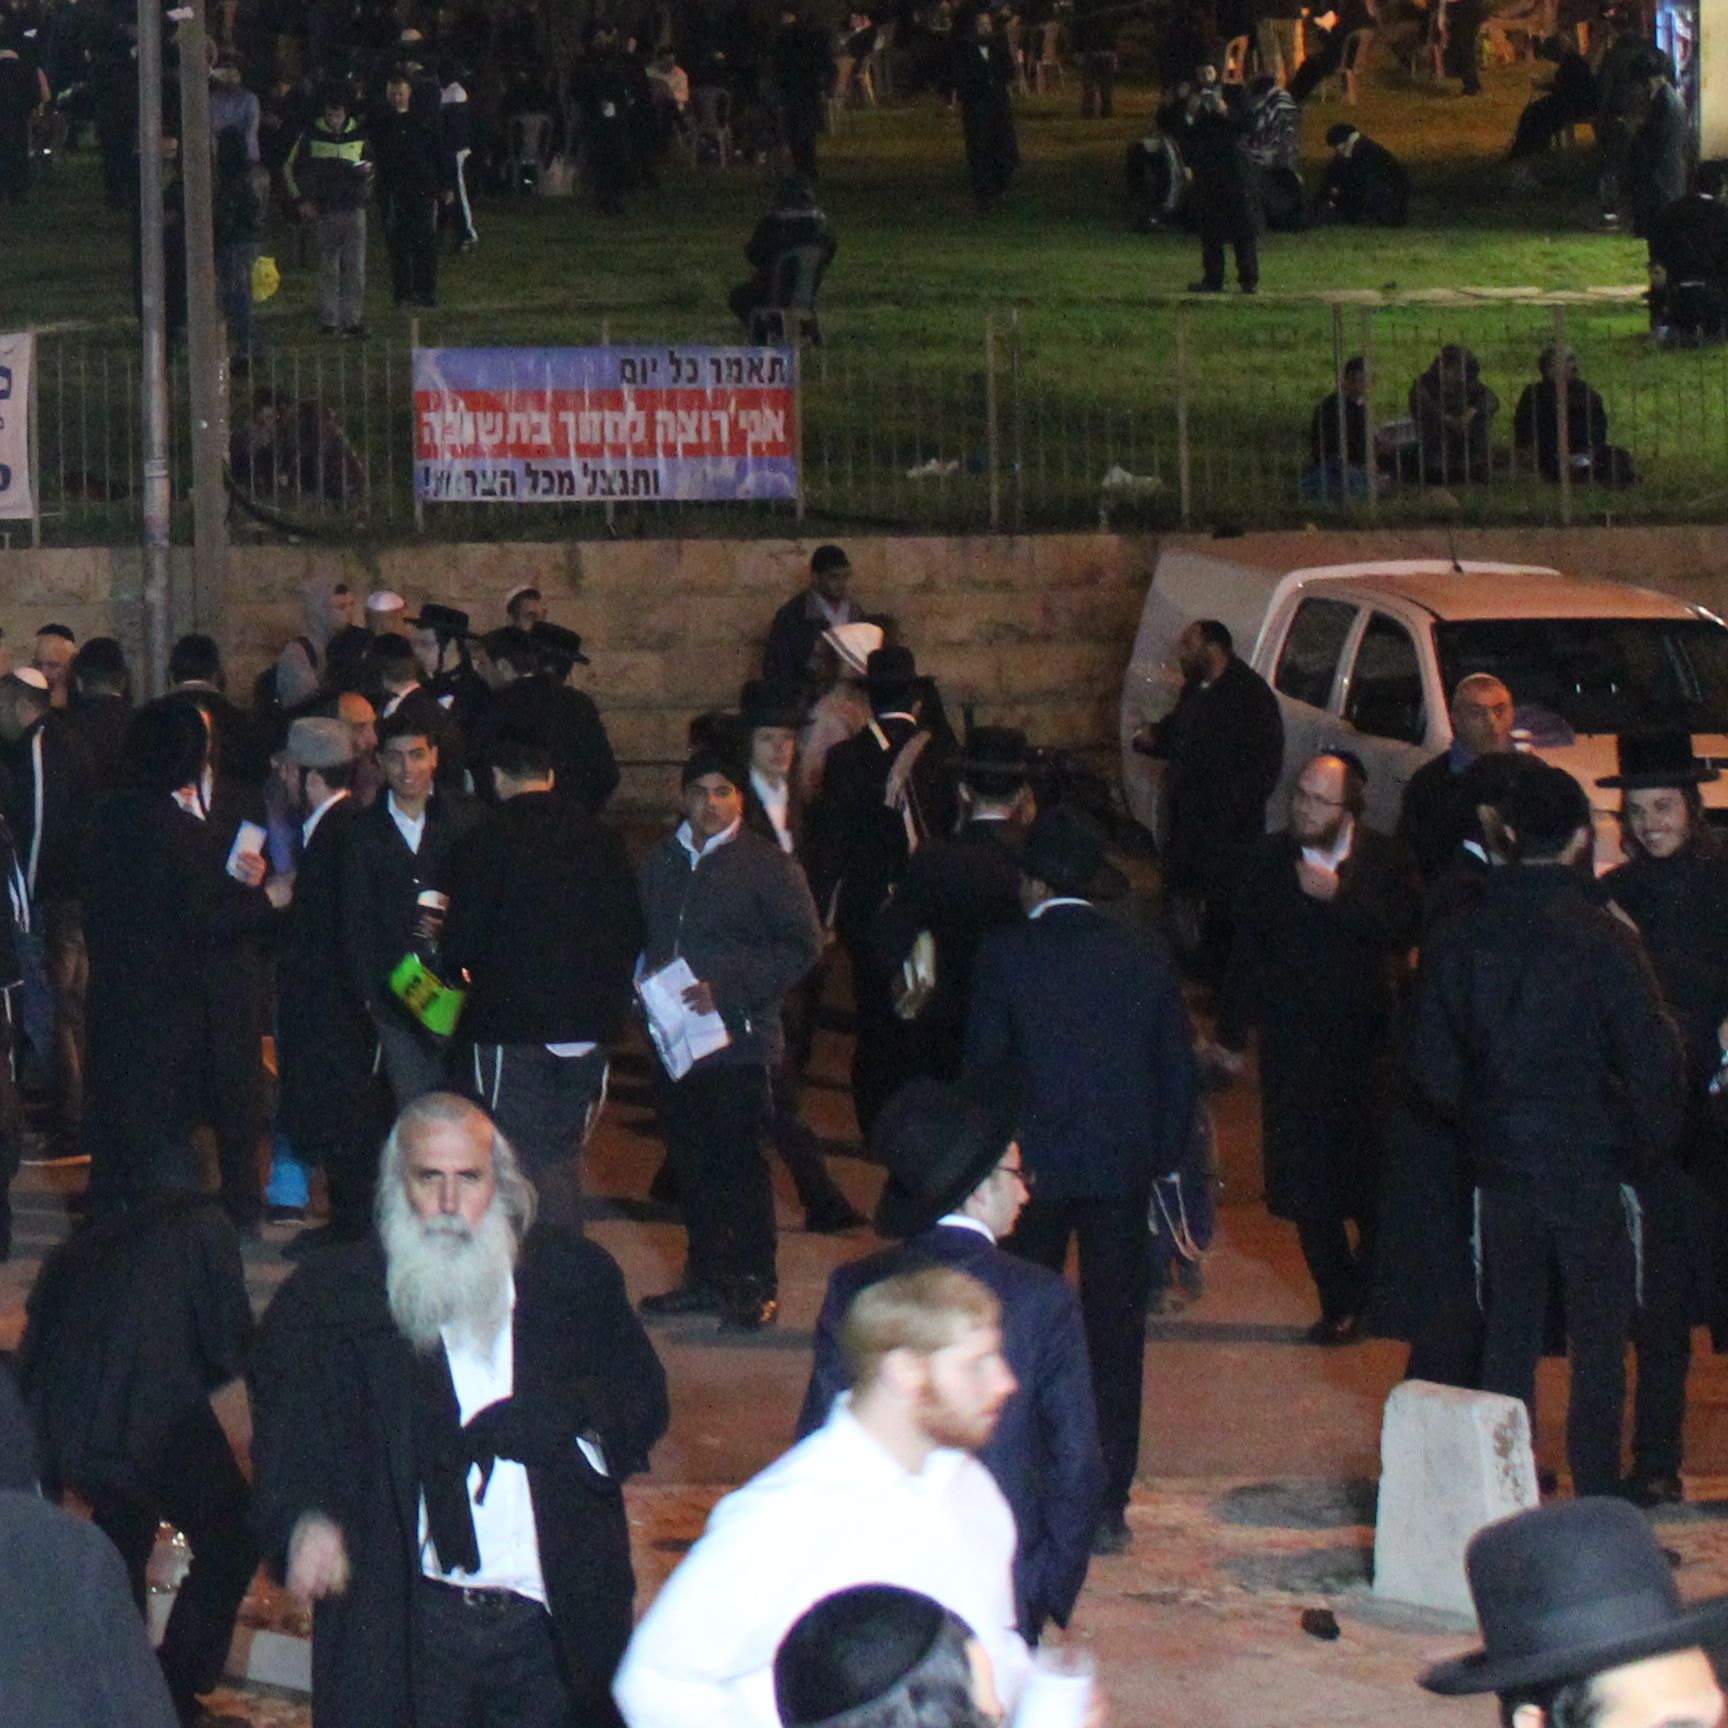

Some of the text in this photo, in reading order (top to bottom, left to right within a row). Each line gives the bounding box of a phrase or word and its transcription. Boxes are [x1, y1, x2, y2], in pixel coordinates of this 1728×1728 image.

[619, 351, 786, 385] תאמר כל יום
[656, 409, 730, 444] רוצה
[525, 461, 576, 495] מכל
